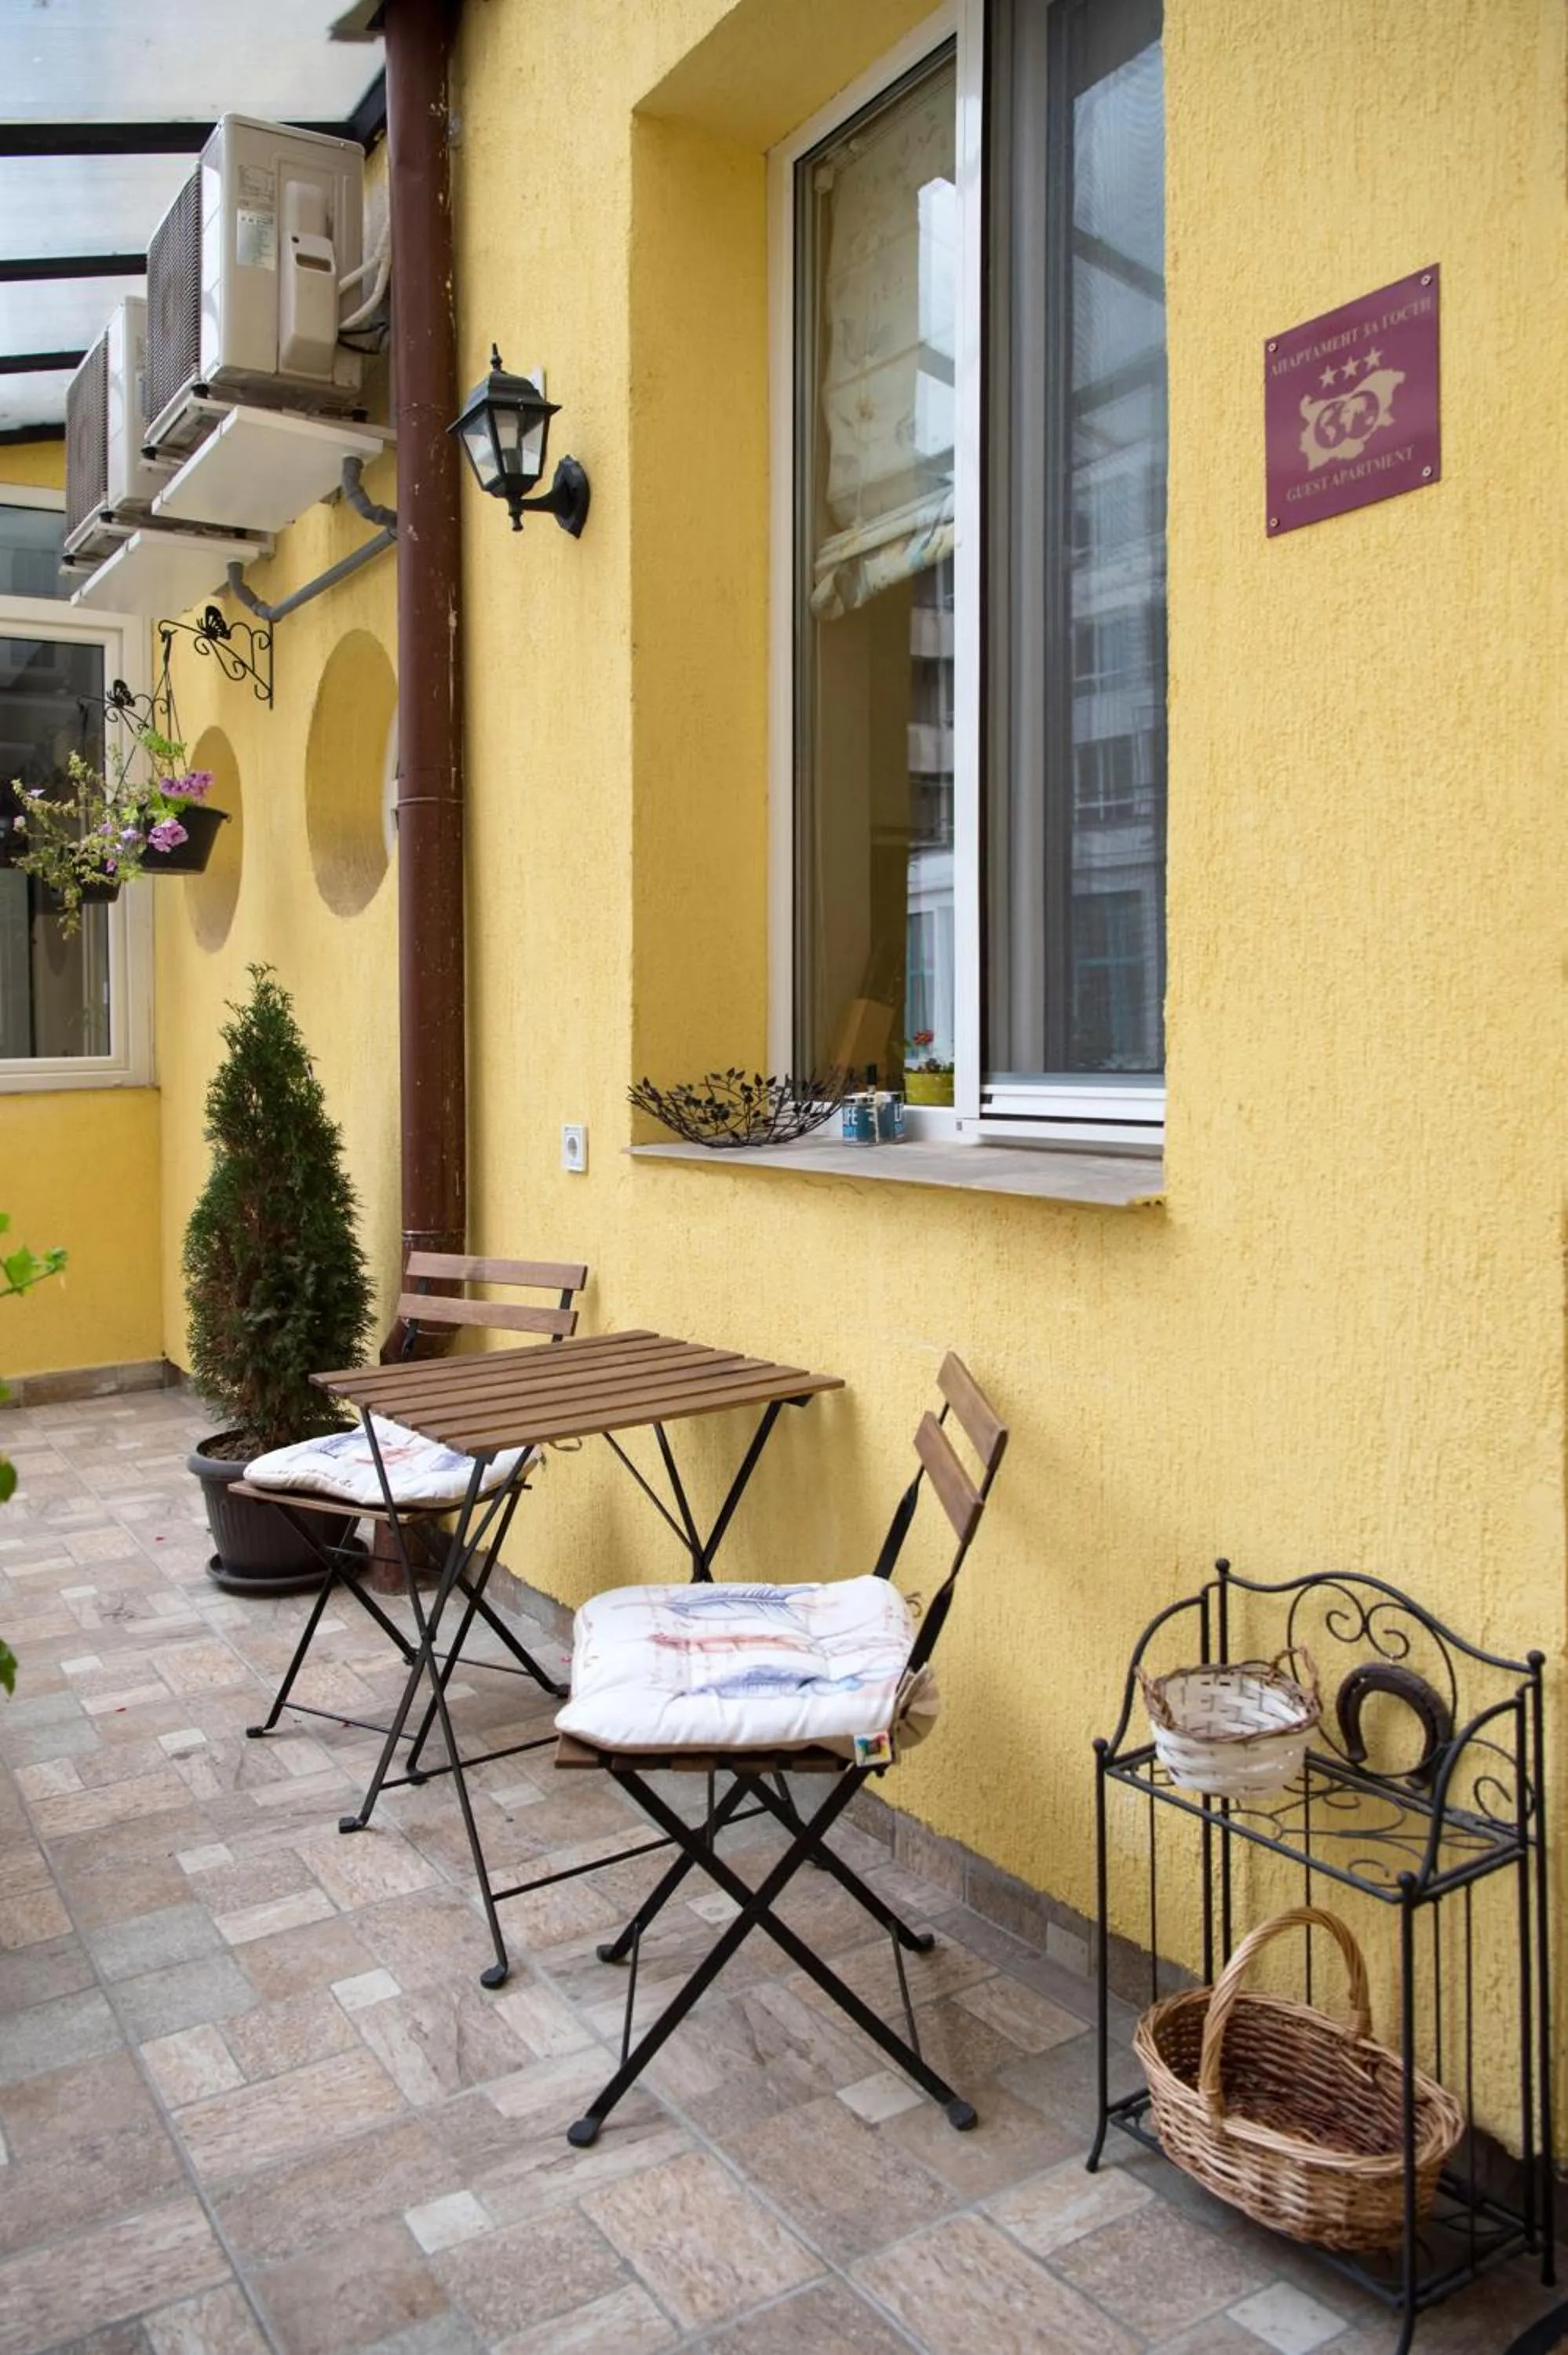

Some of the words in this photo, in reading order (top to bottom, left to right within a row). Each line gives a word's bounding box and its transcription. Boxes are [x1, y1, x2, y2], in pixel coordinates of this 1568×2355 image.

[1271, 328, 1358, 377] АПАРТАМЕНТ
[1363, 320, 1379, 338] ЗА
[1382, 296, 1431, 330] ГОСТИ
[1286, 476, 1329, 502] GUEST
[1332, 444, 1415, 487] APARTMENT
